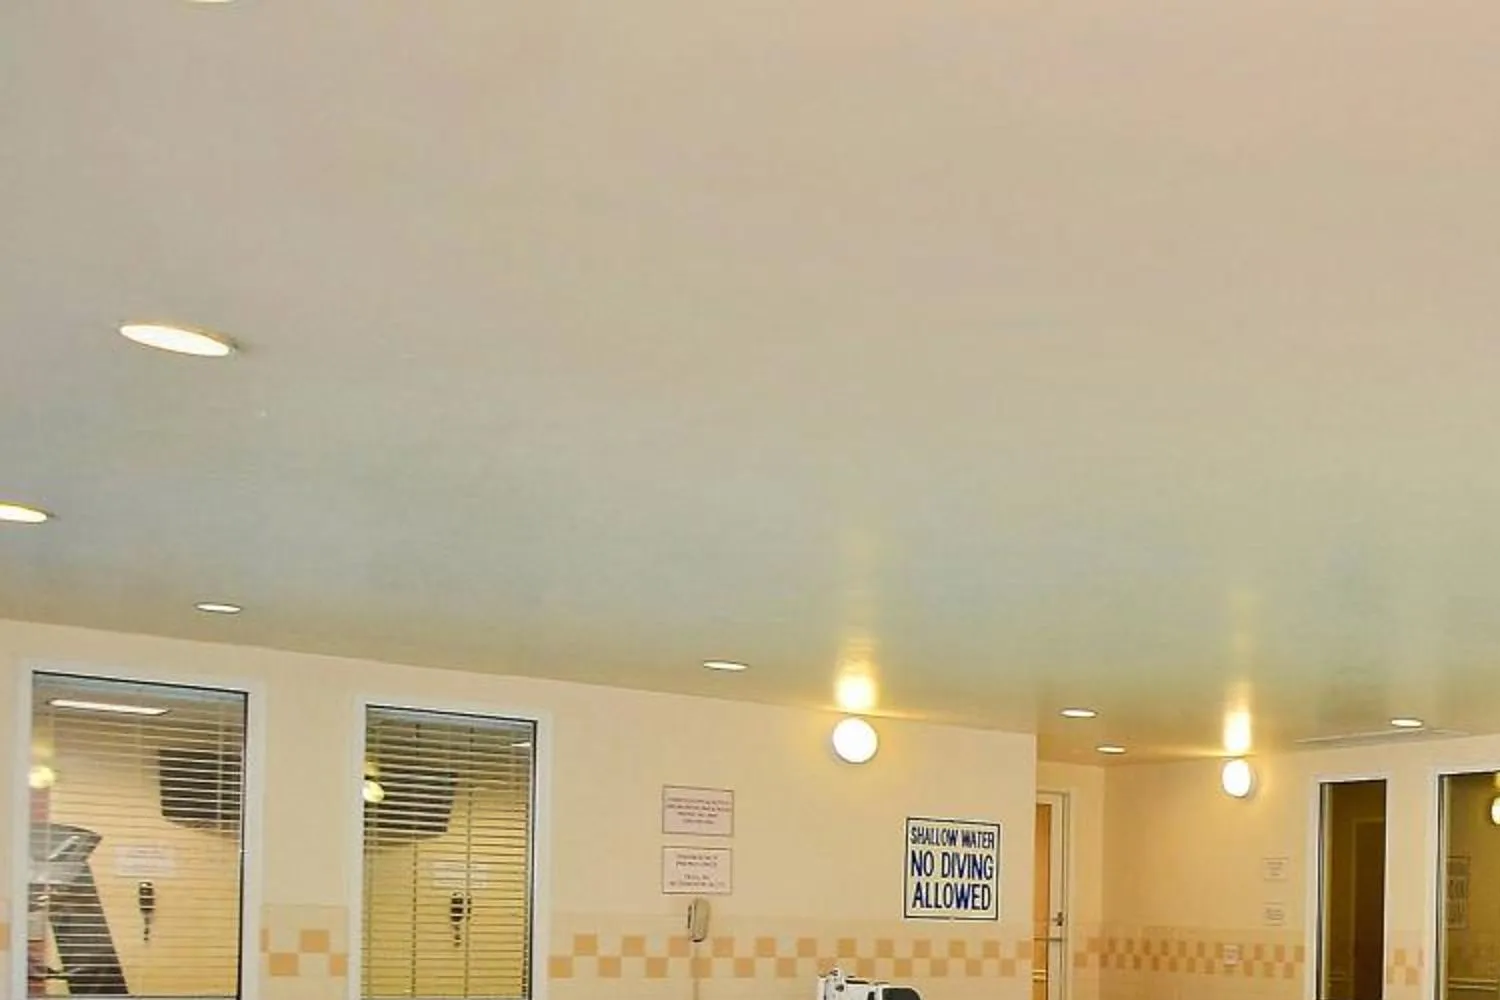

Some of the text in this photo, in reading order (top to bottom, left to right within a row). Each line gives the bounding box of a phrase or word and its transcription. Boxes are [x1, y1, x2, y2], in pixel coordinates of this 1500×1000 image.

[910, 826, 995, 850] SHALLOW WATER
[911, 850, 994, 880] NO DIVING
[911, 882, 991, 911] ALLOWED
